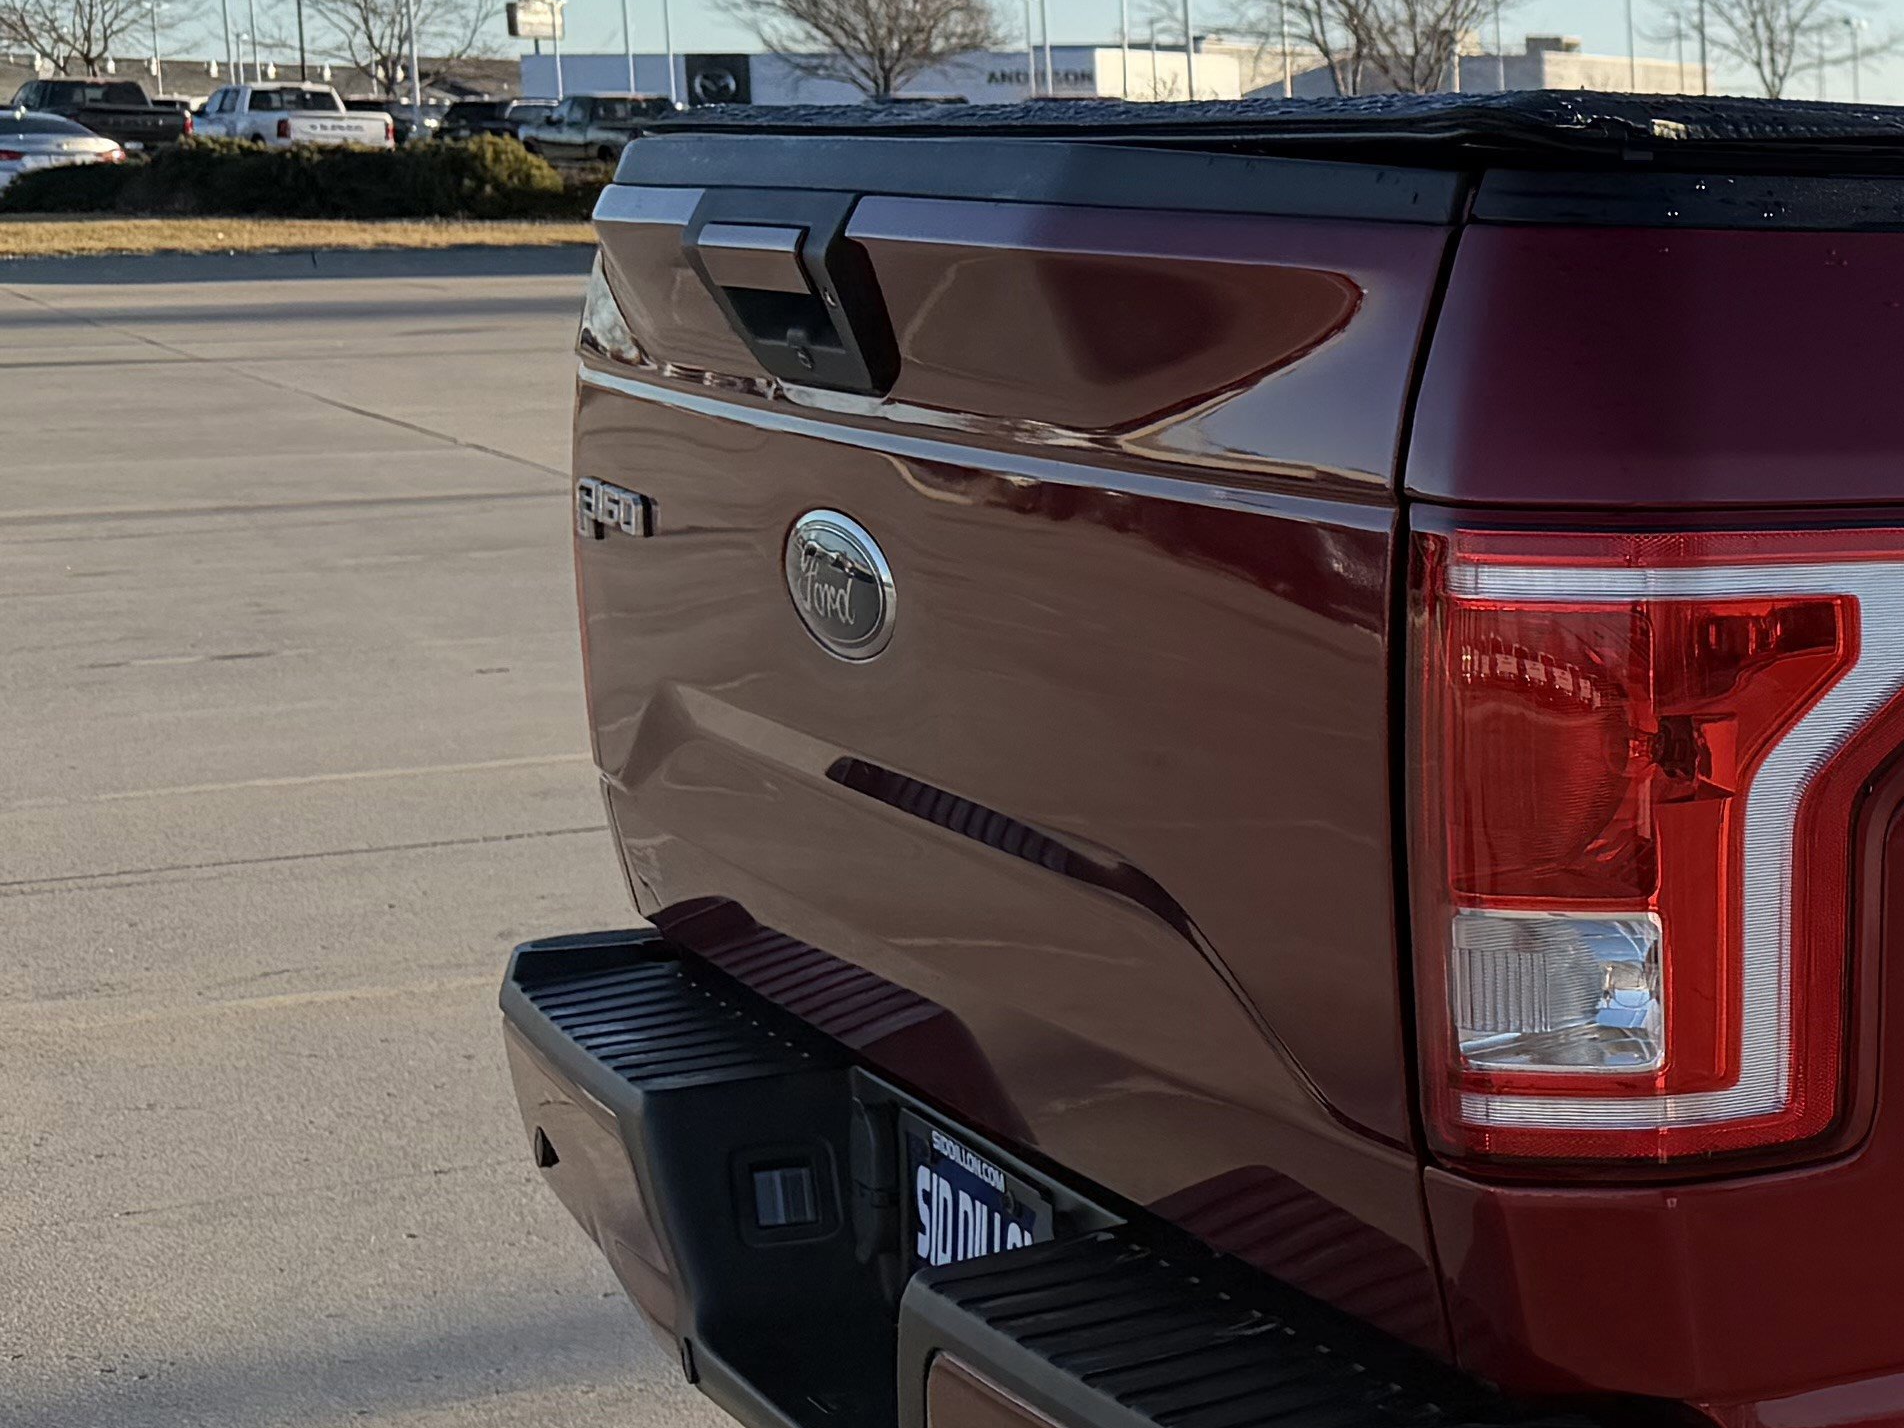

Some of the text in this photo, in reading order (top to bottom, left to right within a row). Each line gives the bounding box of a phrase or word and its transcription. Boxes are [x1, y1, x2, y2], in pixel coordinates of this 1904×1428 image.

[987, 70, 1094, 85] ANDSON
[932, 1130, 1005, 1193] SIDDILLON.COM
[917, 1164, 1034, 1266] SID DILL
